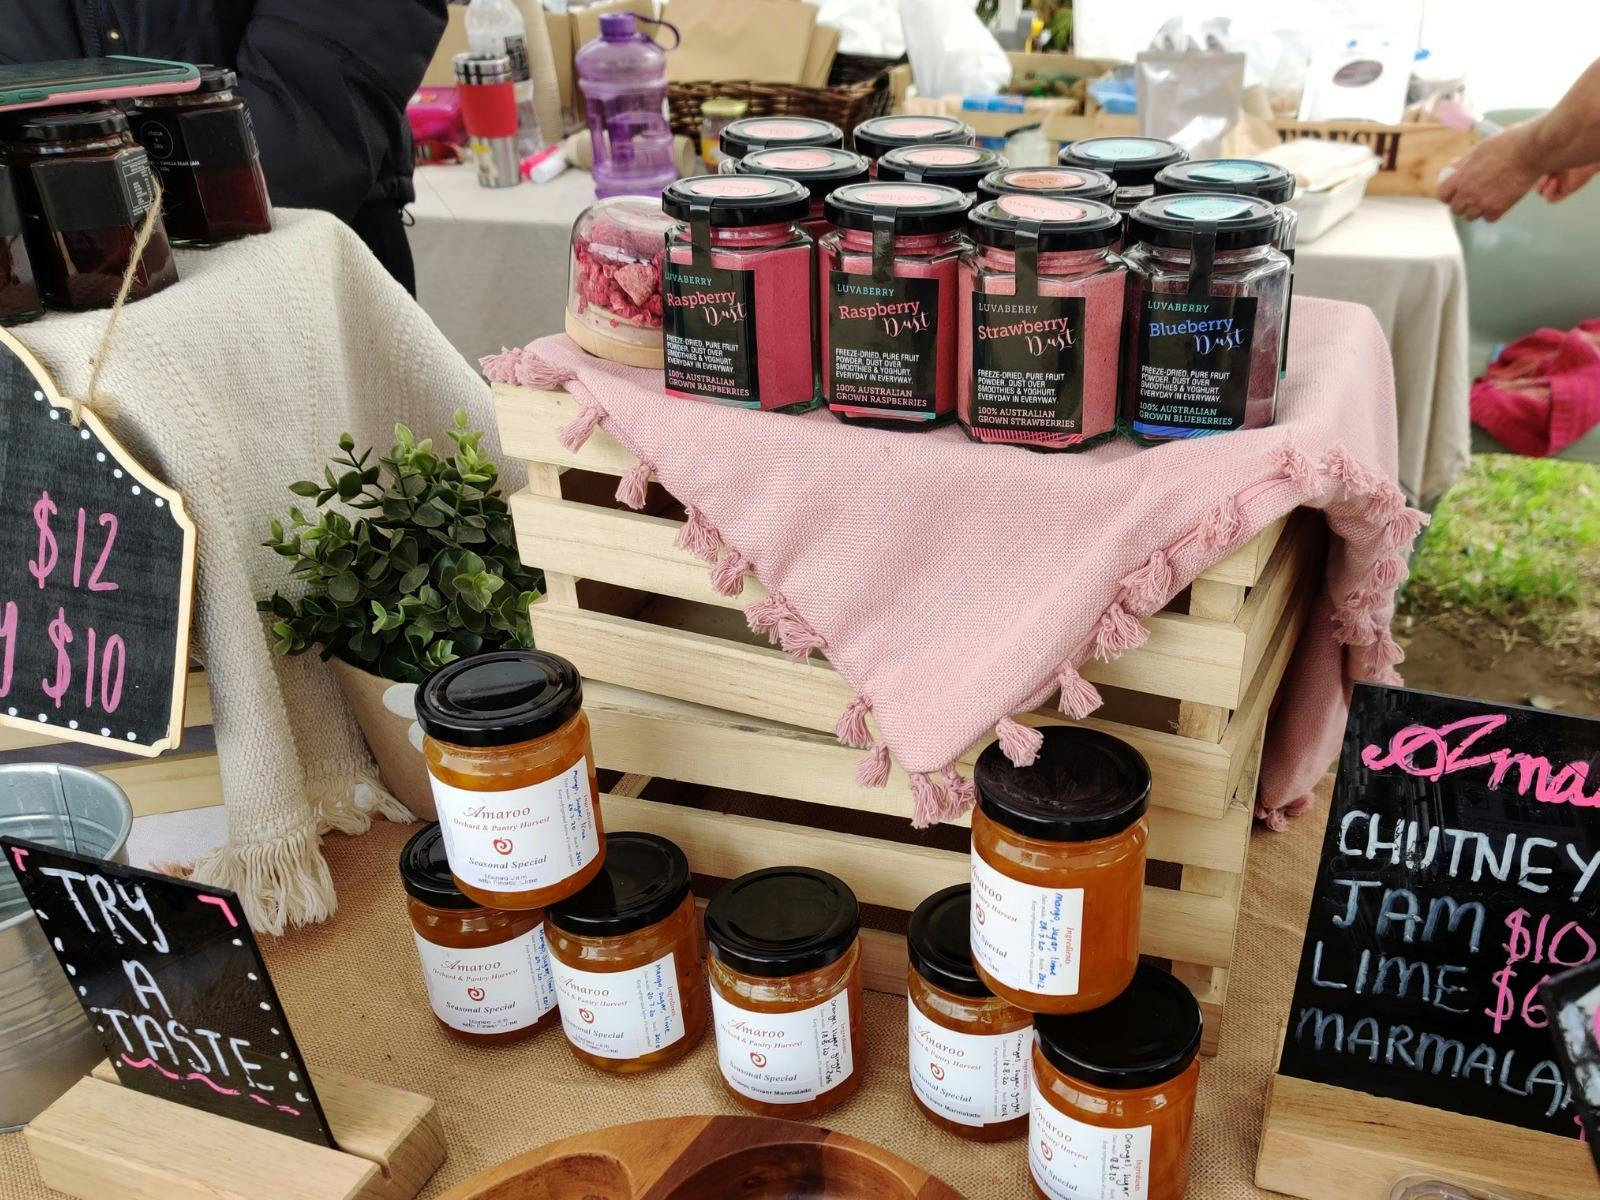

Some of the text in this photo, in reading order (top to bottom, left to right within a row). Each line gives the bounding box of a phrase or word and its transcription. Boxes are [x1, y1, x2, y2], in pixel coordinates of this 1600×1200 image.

[837, 284, 894, 296] LUVABERRY
[667, 291, 736, 308] Raspberry
[1148, 300, 1209, 313] LUVABERRY
[704, 302, 746, 326] Dust
[839, 301, 920, 320] Raspberry
[978, 303, 1038, 314] LUVABERRY
[882, 312, 930, 337] Dust
[978, 317, 1068, 339] Strawberry
[1149, 318, 1234, 336] Blueberry
[706, 341, 721, 349] PURE
[722, 342, 738, 351] FRUIT
[1025, 328, 1077, 356] Dust
[1193, 328, 1246, 355] Dust
[667, 349, 697, 360] SMOOTHIES
[691, 346, 707, 355] DUST
[708, 348, 723, 356] OVER
[901, 354, 919, 362] FRUIT
[668, 357, 693, 367] EVERYDAY
[695, 361, 701, 369] IN
[836, 364, 871, 373] SMOOTHIES
[669, 369, 735, 386] 100% AUSTRALIAN
[836, 371, 867, 380] EVERYDAY
[1026, 372, 1043, 380] PURE
[1210, 372, 1230, 380] FRUIT
[669, 378, 749, 396] GROWN RASPBERRIES
[836, 384, 912, 397] 100% AUSTRALIAN
[978, 385, 1014, 394] SMOOTHIES
[1140, 389, 1172, 399] EVERYDAY
[1141, 381, 1177, 392] SMOOTHIES
[836, 392, 927, 407] GROWN RASPBERRIES
[978, 393, 1010, 402] EVERYDAY
[978, 406, 1055, 418] 100% AUSTRALIAN
[1140, 402, 1217, 416] 100% AUSTRALIAN
[978, 416, 1074, 427] GROWN STRAWBERRIES
[1139, 410, 1232, 425] GROWN BLUEBERRIES
[29, 490, 119, 591] $12
[42, 607, 126, 713] $10
[464, 806, 530, 819] Amaroo
[454, 818, 481, 831] Orchard
[520, 816, 550, 828] Harvest
[469, 855, 547, 869] Seasonal Special
[1338, 809, 1600, 902] CHUTNEY
[39, 866, 170, 954] TRY
[1331, 878, 1597, 967] JAM $10
[983, 936, 1007, 958] Special
[1065, 927, 1074, 964] Ingredients
[441, 960, 500, 972] Amaroo
[1049, 957, 1062, 976] lime
[492, 968, 518, 980] Harvest
[1312, 941, 1470, 1014] LIME
[122, 960, 174, 1018] A
[559, 976, 609, 997] Amaroo
[446, 1001, 516, 1014] Seasonal Special
[668, 986, 677, 1016] Ingredients
[664, 1016, 672, 1035] lime
[728, 1019, 784, 1038] Amaroo
[593, 1030, 624, 1039] Special
[101, 1007, 274, 1091] TASTE
[749, 1040, 771, 1049] Pantry
[916, 1028, 965, 1057] Amaroo
[953, 1061, 981, 1071] Harvest
[1296, 1006, 1575, 1118] MARMALA
[729, 1060, 797, 1083] Seasonal Special
[940, 1088, 972, 1103] Special
[1049, 1169, 1078, 1191] Special
[1135, 1160, 1143, 1191] Ingredients
